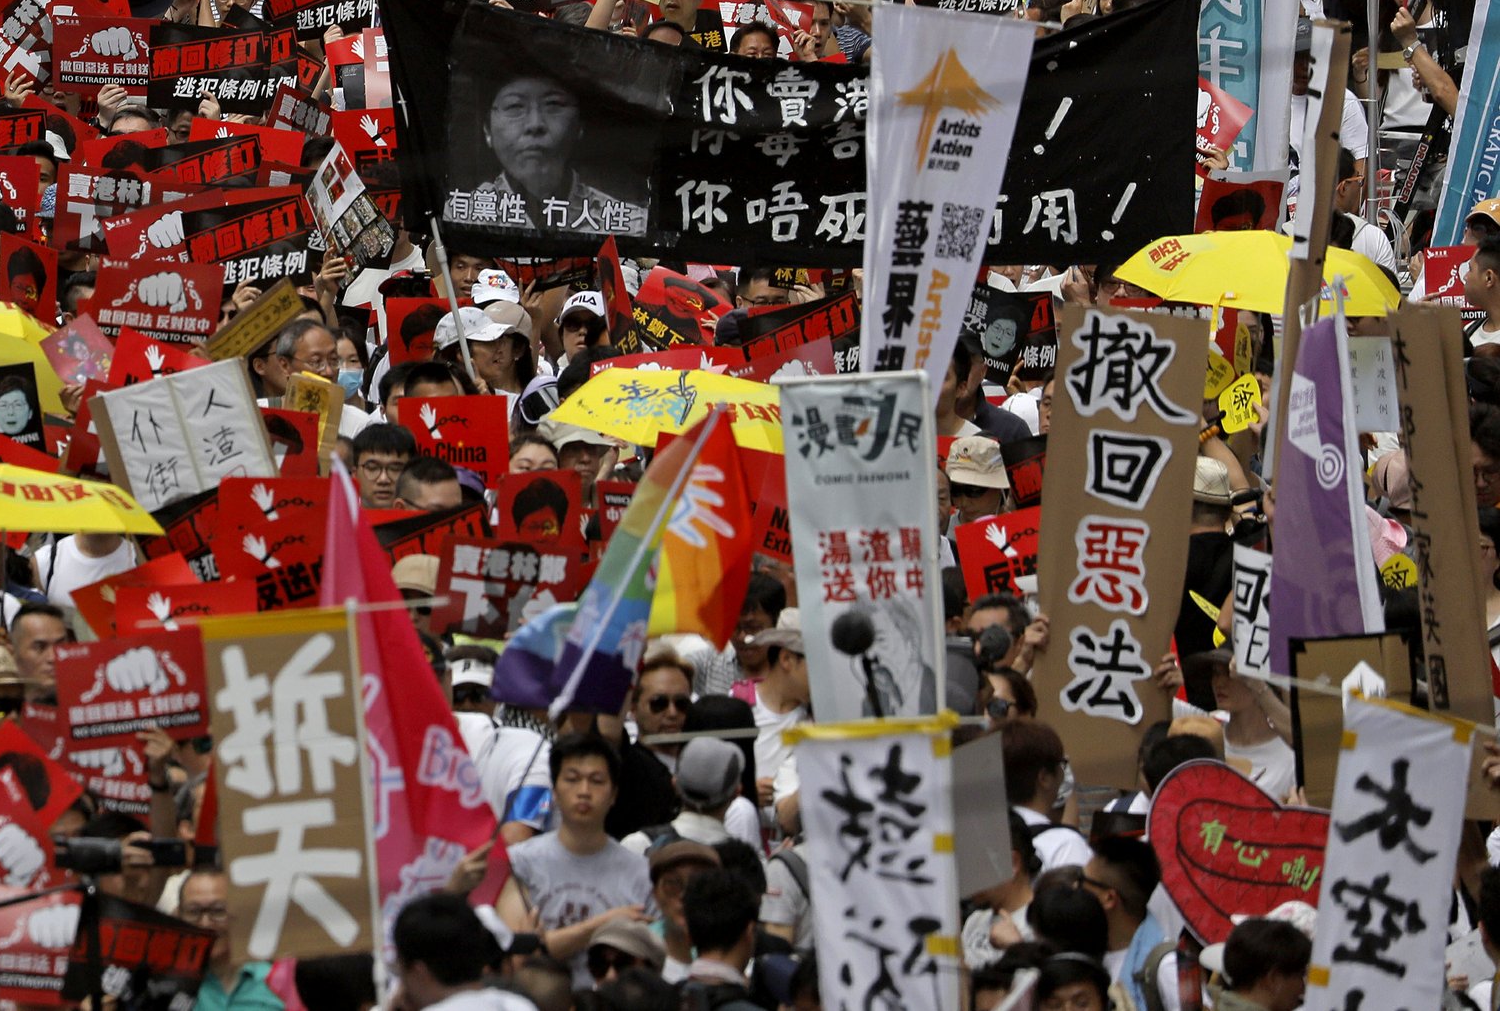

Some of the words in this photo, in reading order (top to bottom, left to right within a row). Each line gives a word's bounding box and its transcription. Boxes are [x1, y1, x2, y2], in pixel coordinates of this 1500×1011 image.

[59, 59, 110, 74] 撤回惡法
[153, 35, 264, 74] 撤回修訂
[62, 75, 74, 83] NO
[76, 75, 125, 84] EXTRADITION
[127, 77, 136, 85] TO
[173, 77, 261, 100] 逃犯條例
[694, 64, 871, 127] 你賣港
[937, 118, 983, 139] Artists
[931, 138, 974, 158] Action
[448, 189, 526, 224] 有黨性
[543, 197, 631, 232] 冇人性
[676, 180, 870, 245] 你唔死
[572, 293, 597, 306] FILA
[98, 309, 153, 325] 撤回惡法
[155, 314, 211, 332] 反對送中
[205, 387, 244, 467] 人渣
[132, 408, 180, 505] 仆街
[435, 440, 487, 464] China
[815, 472, 850, 485] COMIC
[1070, 316, 1197, 719] 撤回惡法
[453, 543, 568, 582] 賣港林鄭
[137, 691, 200, 714] 反對送中
[71, 724, 88, 739] NO
[90, 718, 155, 737] EXTRADITION
[155, 716, 169, 728] TO
[172, 711, 202, 727] CHINA
[217, 632, 363, 961] 拆天
